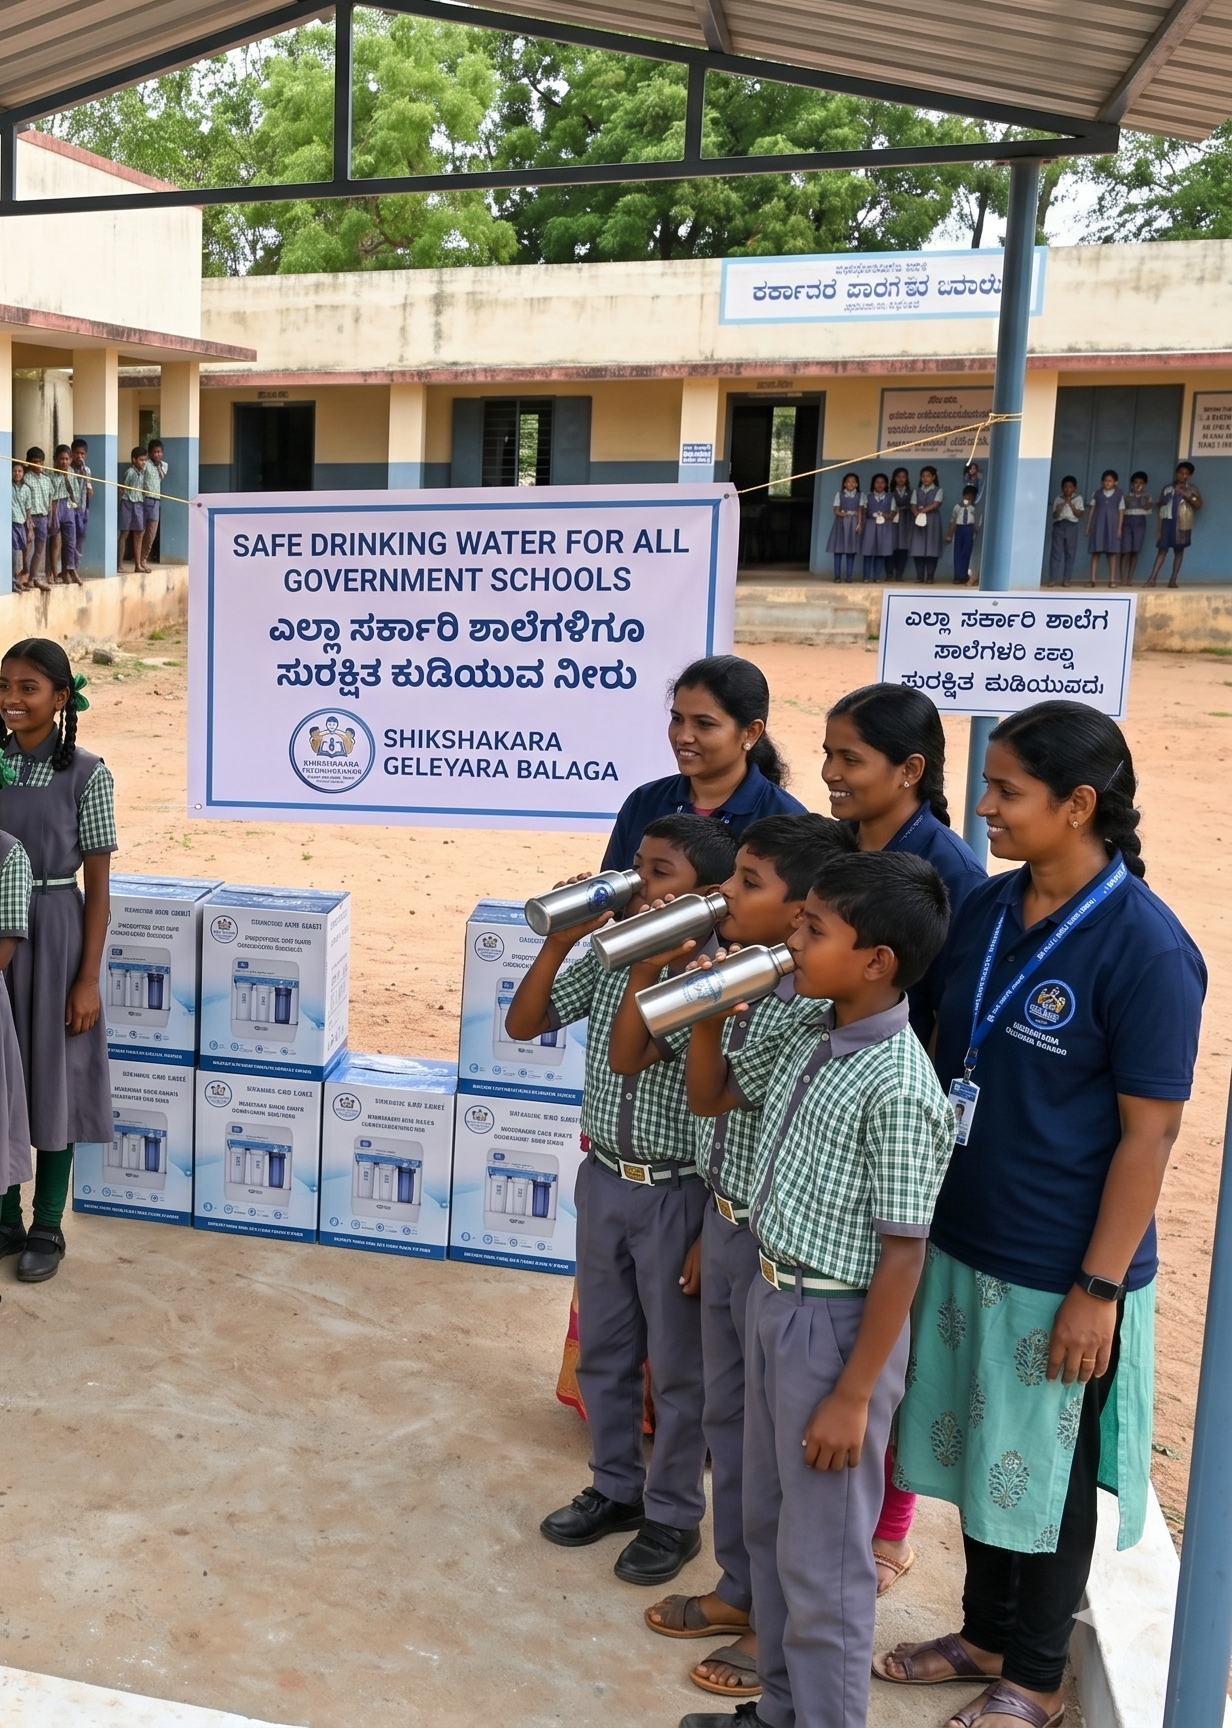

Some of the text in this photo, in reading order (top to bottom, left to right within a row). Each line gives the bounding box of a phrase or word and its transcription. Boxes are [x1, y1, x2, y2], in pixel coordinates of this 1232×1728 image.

[232, 528, 690, 558] SAFE DRINKING WATER FOR ALL
[283, 566, 632, 593] GOVERNMENT SCHOOLS
[269, 609, 646, 654] ಎಲ್ಲಾ ಸರ್ಕಾರಿ ಶಾಲೆಗಳಿಗೂ
[905, 610, 952, 636] ಎಲ್ಲಾ
[961, 609, 1036, 629] ಸರ್ಕಾರಿ
[277, 656, 637, 699] ಸುರಕ್ಷಿತ ಕುಡಿಯುವ ನೀರು
[383, 728, 563, 752] SHIKSHAKARA
[383, 756, 510, 779] GELEYARA
[517, 759, 620, 782] BALAGA
